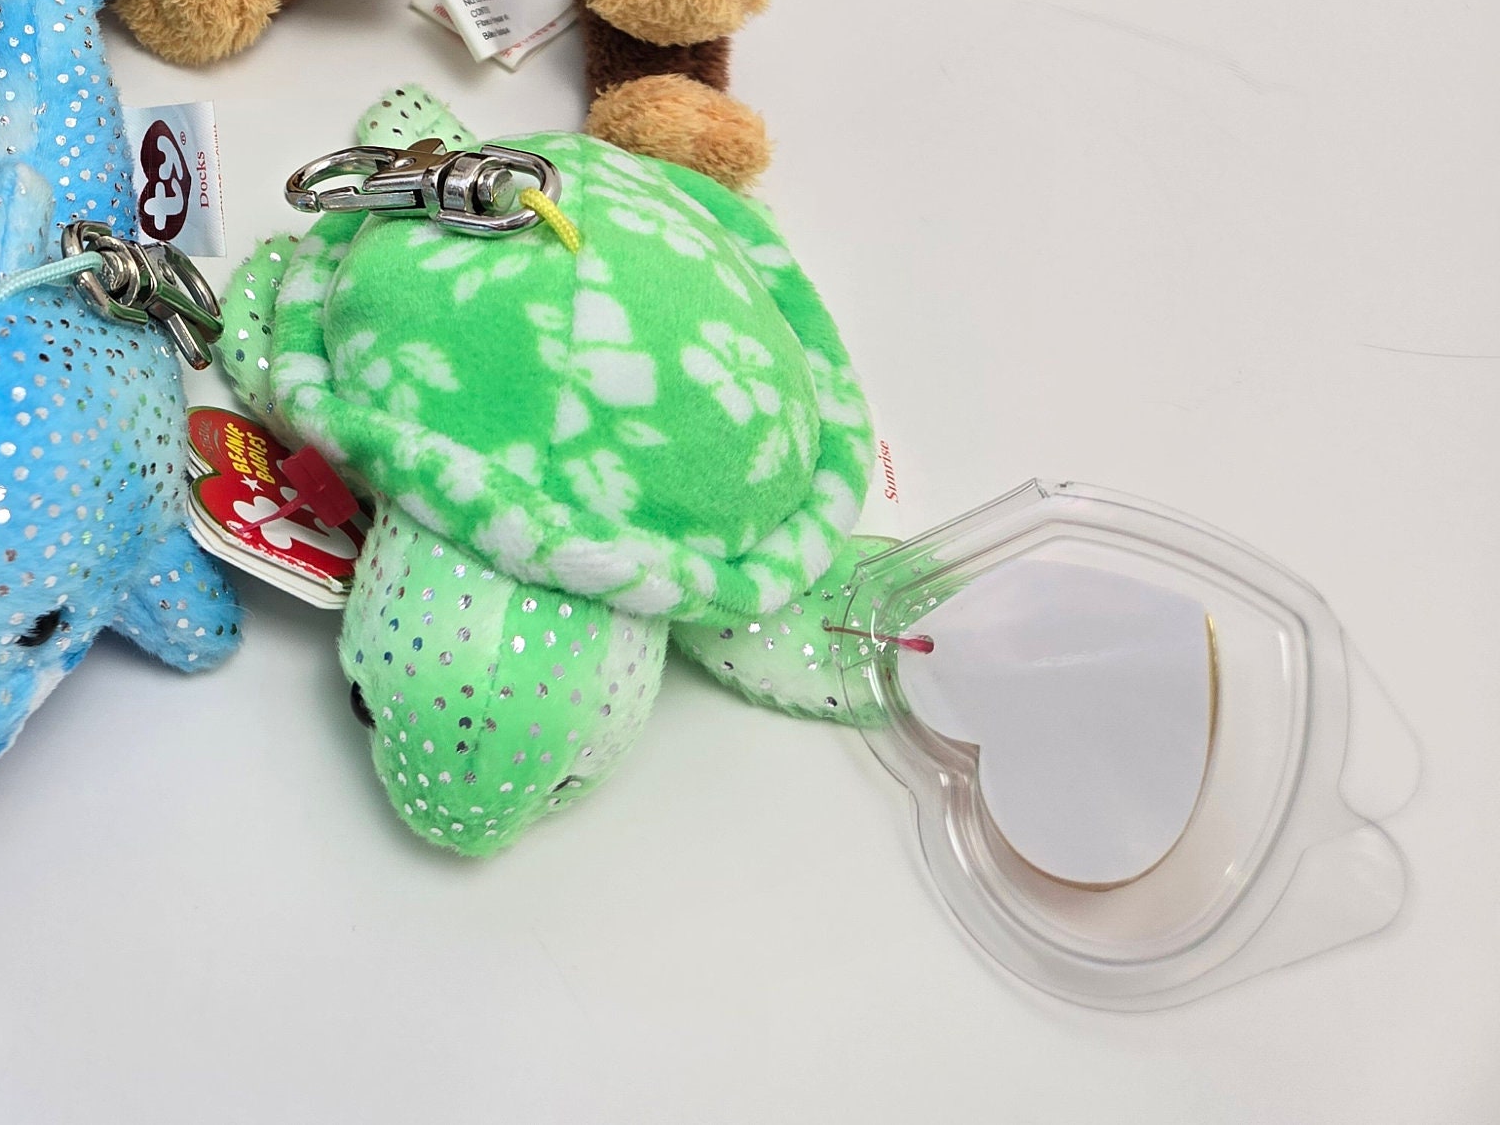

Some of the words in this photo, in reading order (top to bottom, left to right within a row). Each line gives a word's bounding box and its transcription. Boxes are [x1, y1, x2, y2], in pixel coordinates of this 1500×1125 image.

[143, 134, 184, 231] ty
[196, 151, 210, 209] Docks
[224, 422, 252, 475] BEANIE
[246, 431, 276, 484] BABIES
[878, 440, 899, 504] Sunrise
